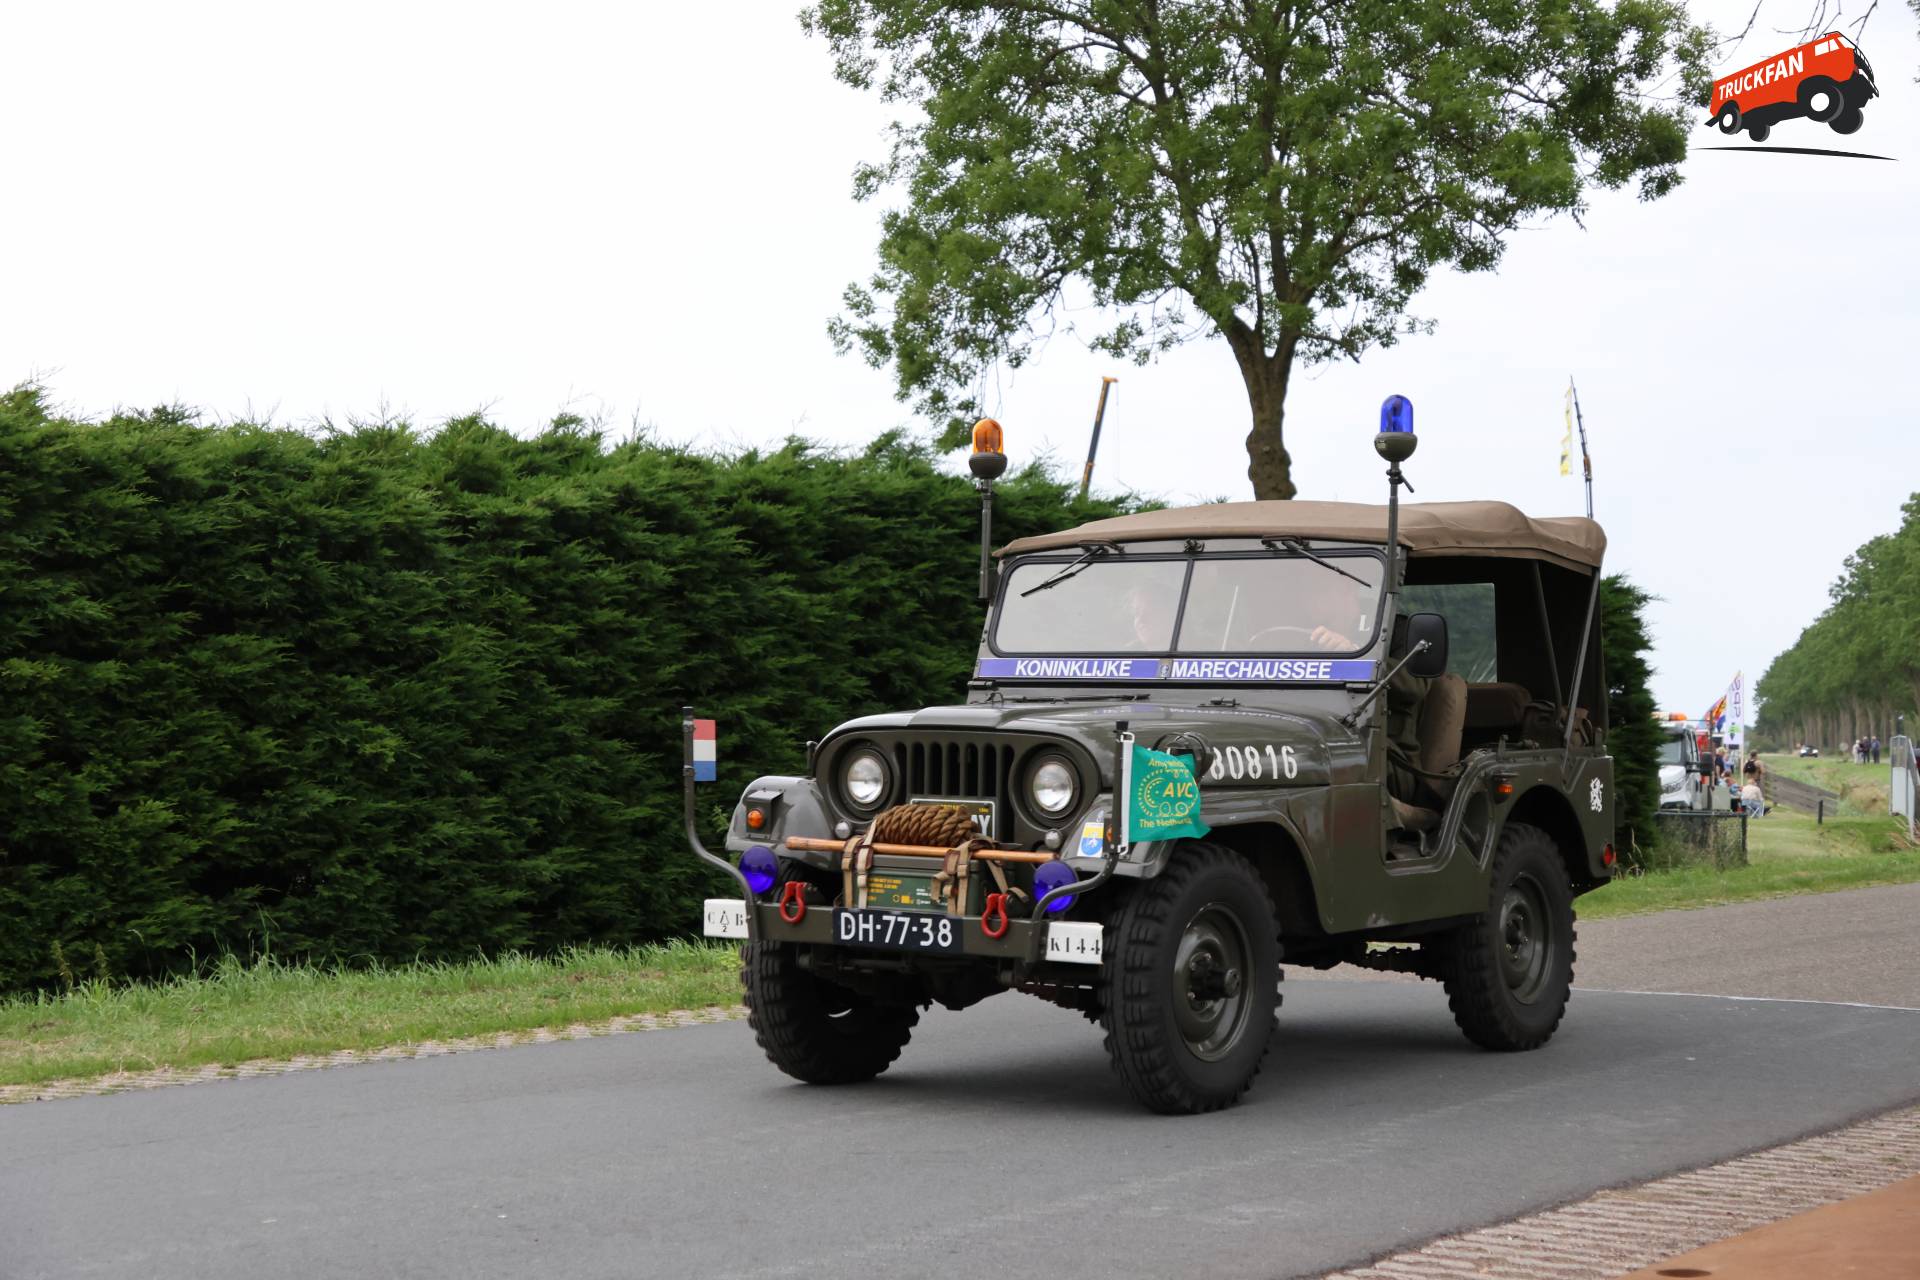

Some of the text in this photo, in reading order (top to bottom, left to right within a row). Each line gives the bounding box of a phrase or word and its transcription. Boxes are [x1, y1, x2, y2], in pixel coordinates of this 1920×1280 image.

[1015, 660, 1332, 679] KONINKLIJKE MARECHAUSSEE
[1162, 782, 1193, 798] AVC
[840, 912, 953, 947] DH-77-38
